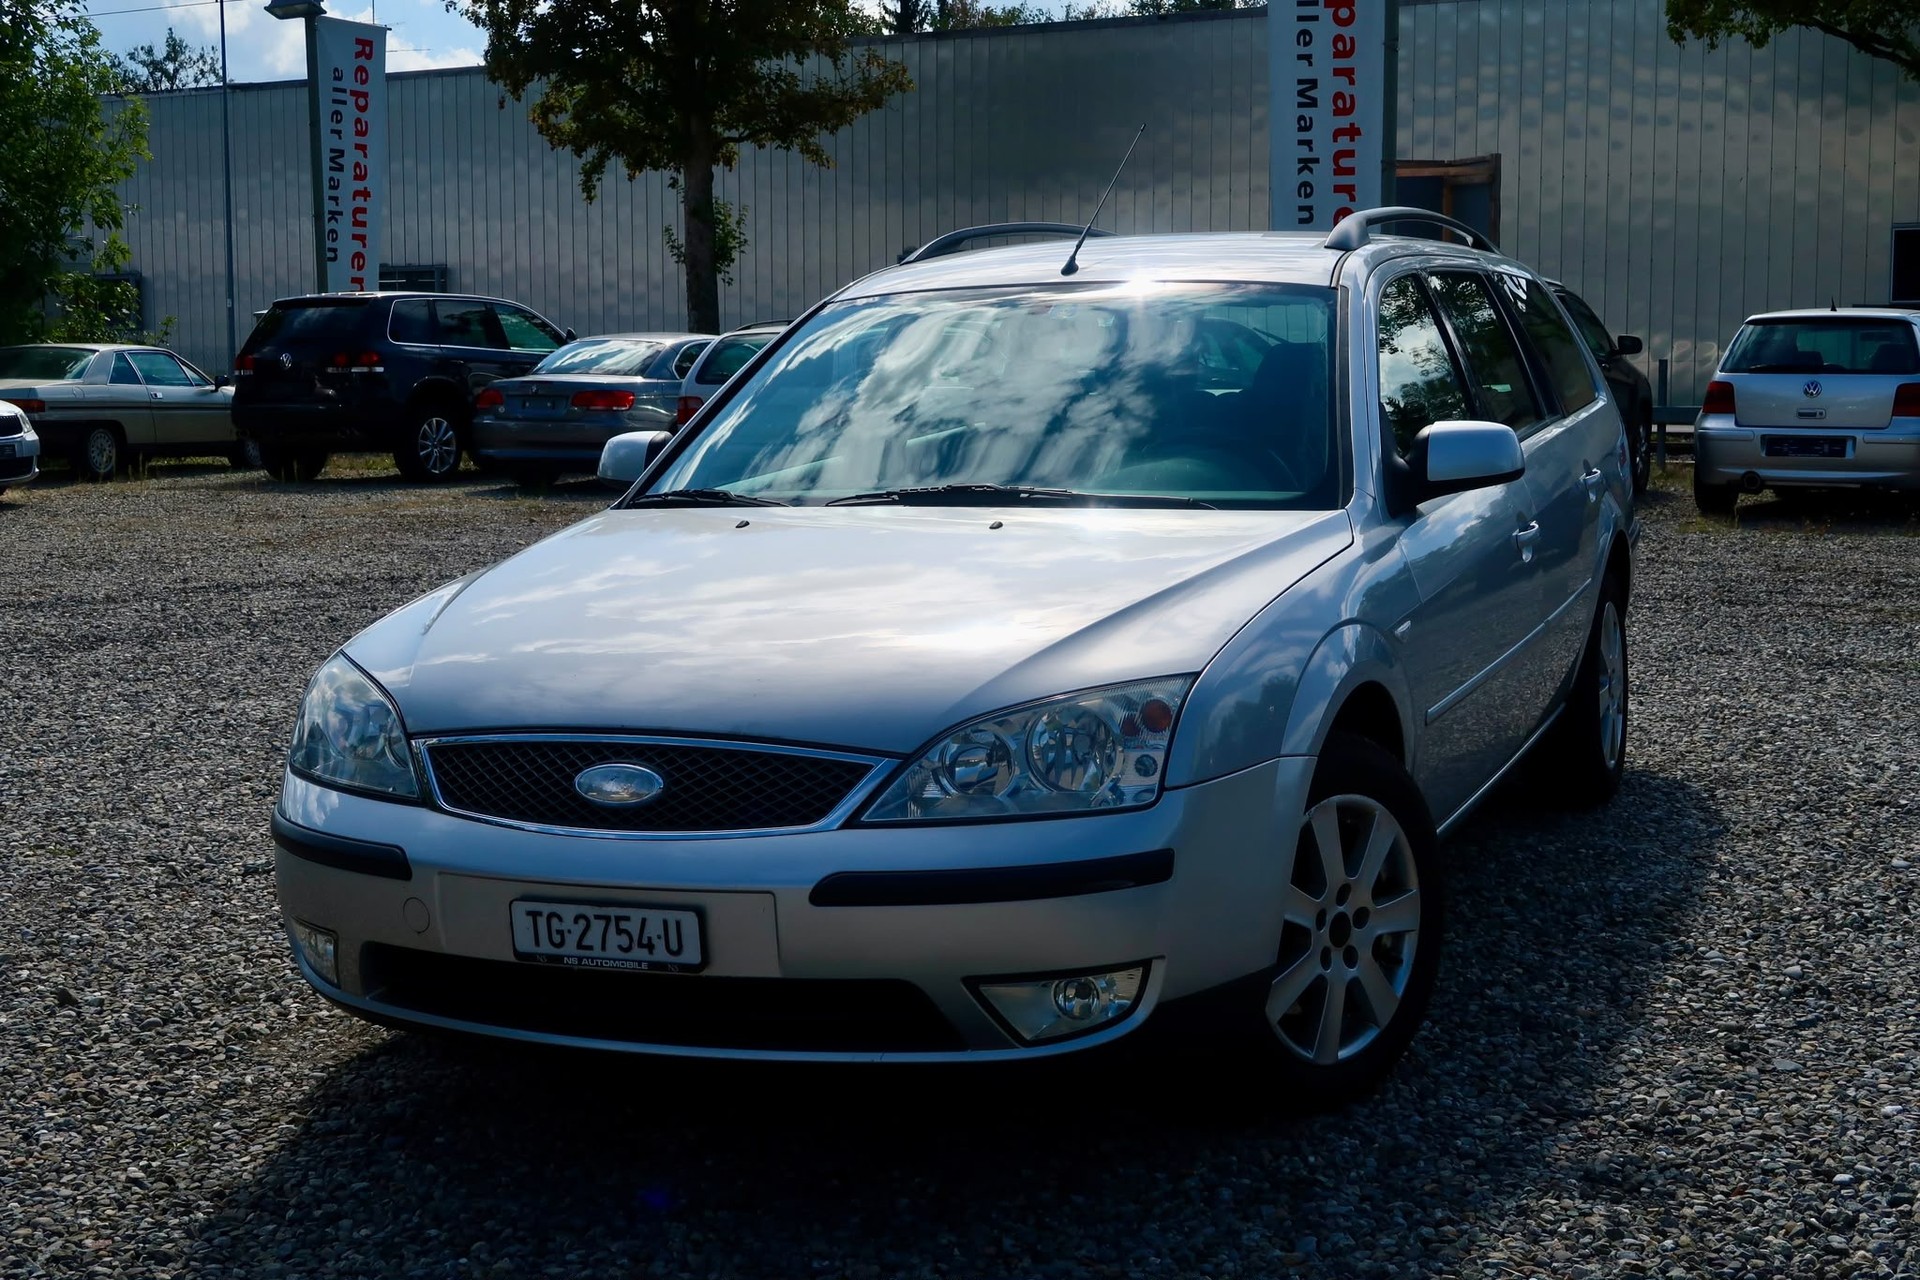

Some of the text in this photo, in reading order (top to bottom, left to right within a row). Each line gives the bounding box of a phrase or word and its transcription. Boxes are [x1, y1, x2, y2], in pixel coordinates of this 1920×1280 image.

[327, 67, 347, 262] aller Marken
[1297, 78, 1320, 225] Marken
[563, 957, 648, 969] NS AUTOMOBILE
